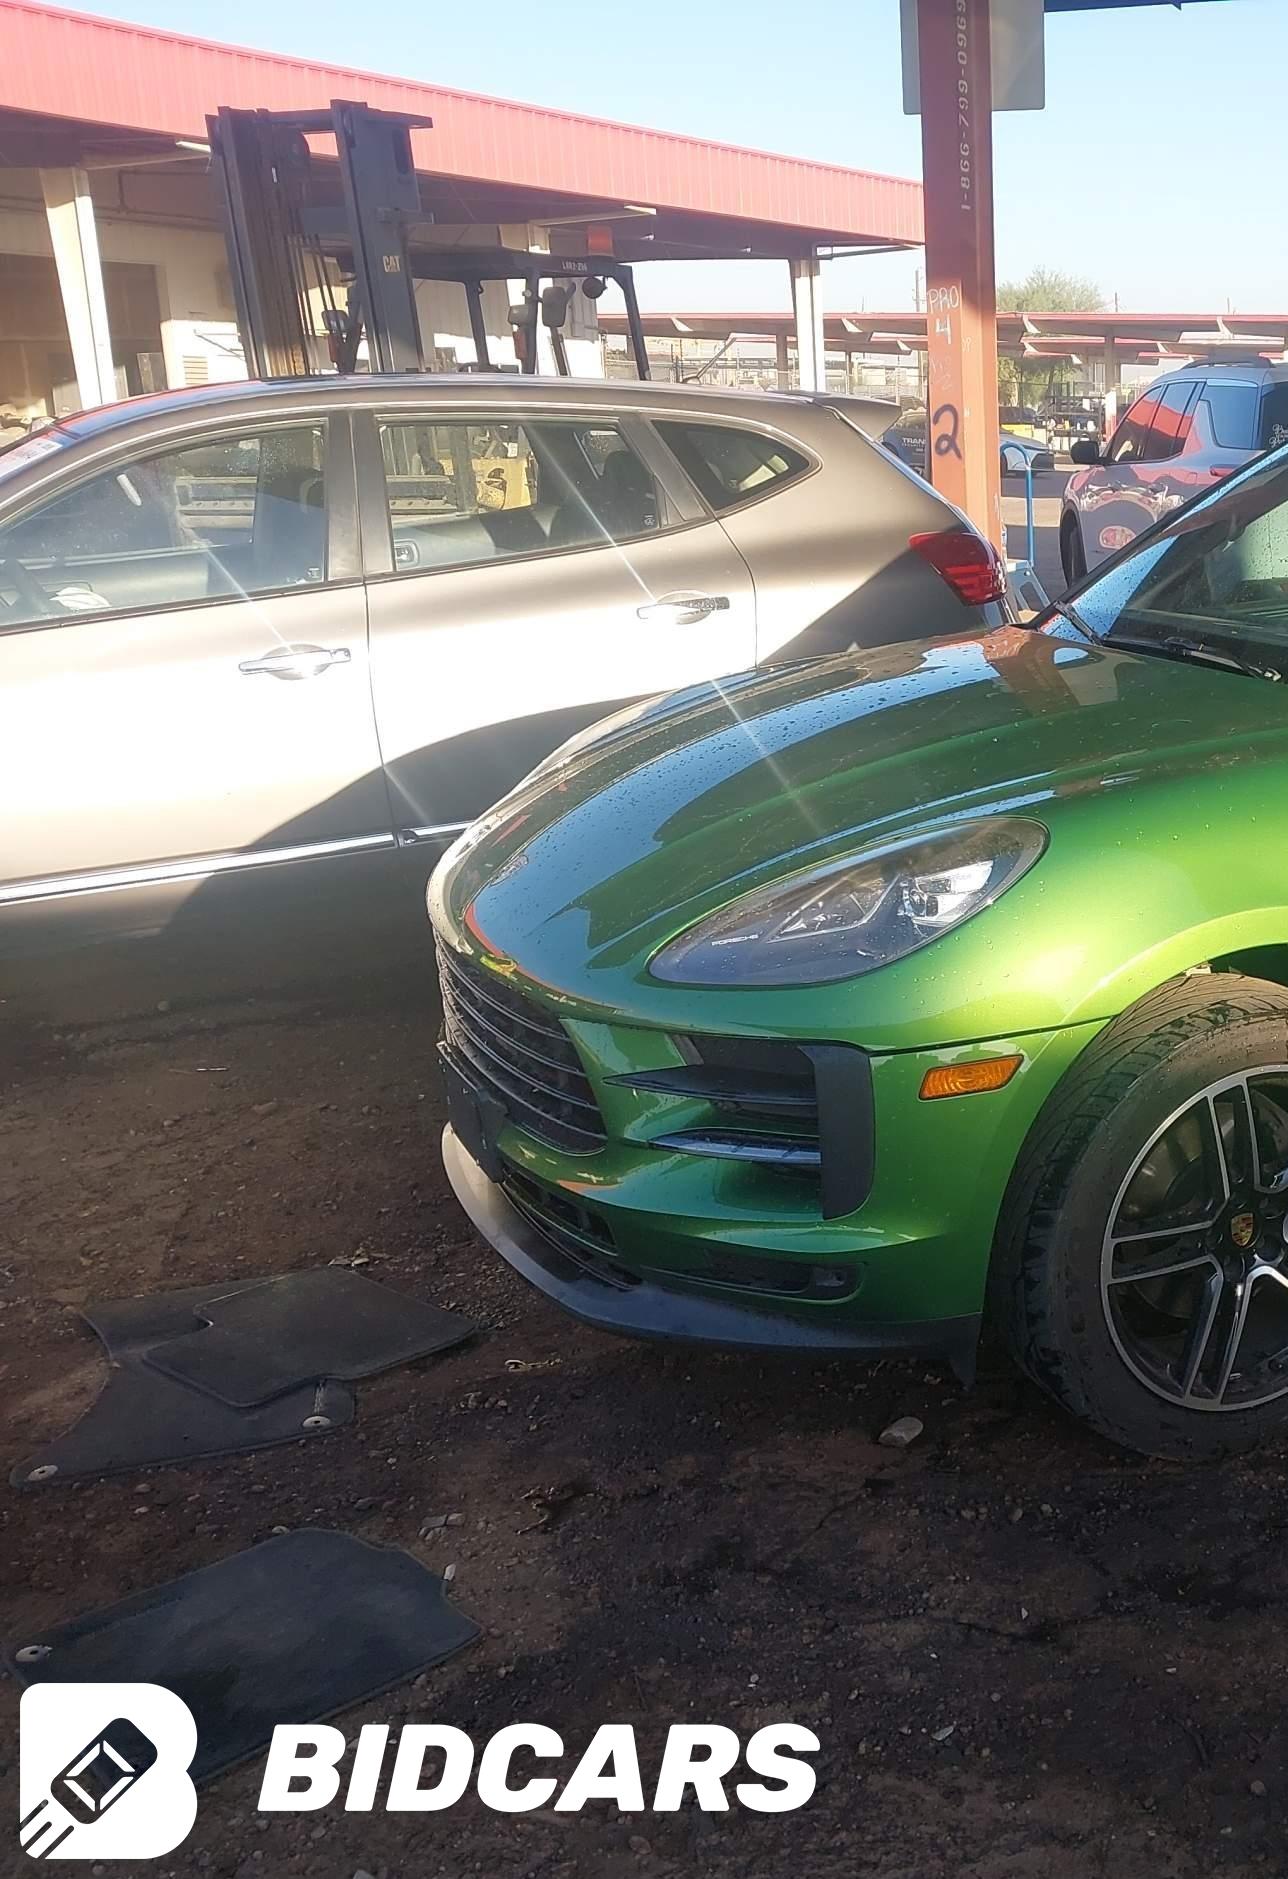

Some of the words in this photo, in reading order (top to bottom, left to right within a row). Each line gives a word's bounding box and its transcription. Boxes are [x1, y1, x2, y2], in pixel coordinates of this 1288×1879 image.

[382, 255, 401, 272] CAT
[935, 314, 951, 344] 4
[933, 403, 962, 459] 2
[711, 934, 759, 946] PORSCHE
